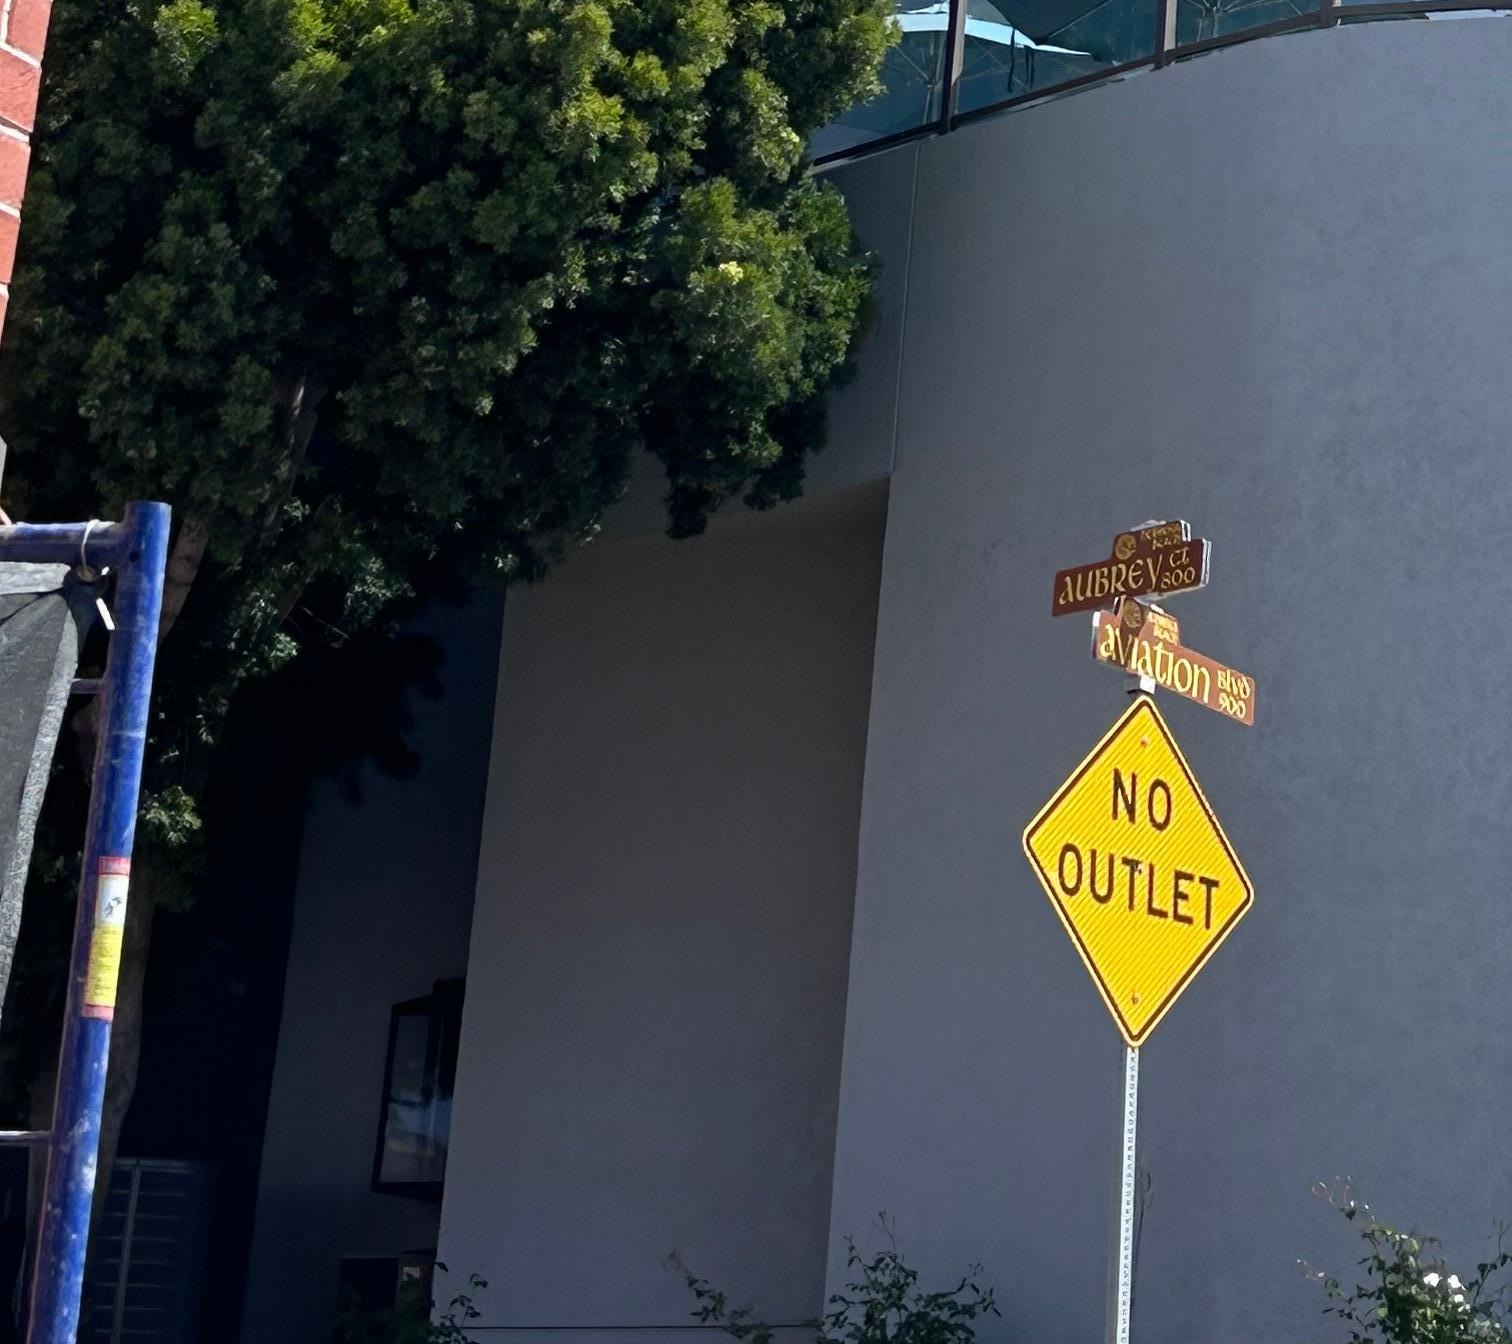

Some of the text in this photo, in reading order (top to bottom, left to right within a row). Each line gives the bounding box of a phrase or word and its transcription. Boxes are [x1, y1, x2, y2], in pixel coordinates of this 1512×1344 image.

[1058, 555, 1163, 605] AUBREY
[1161, 566, 1196, 590] 800
[1112, 767, 1172, 832] NO
[1058, 842, 1220, 930] OUTLET
